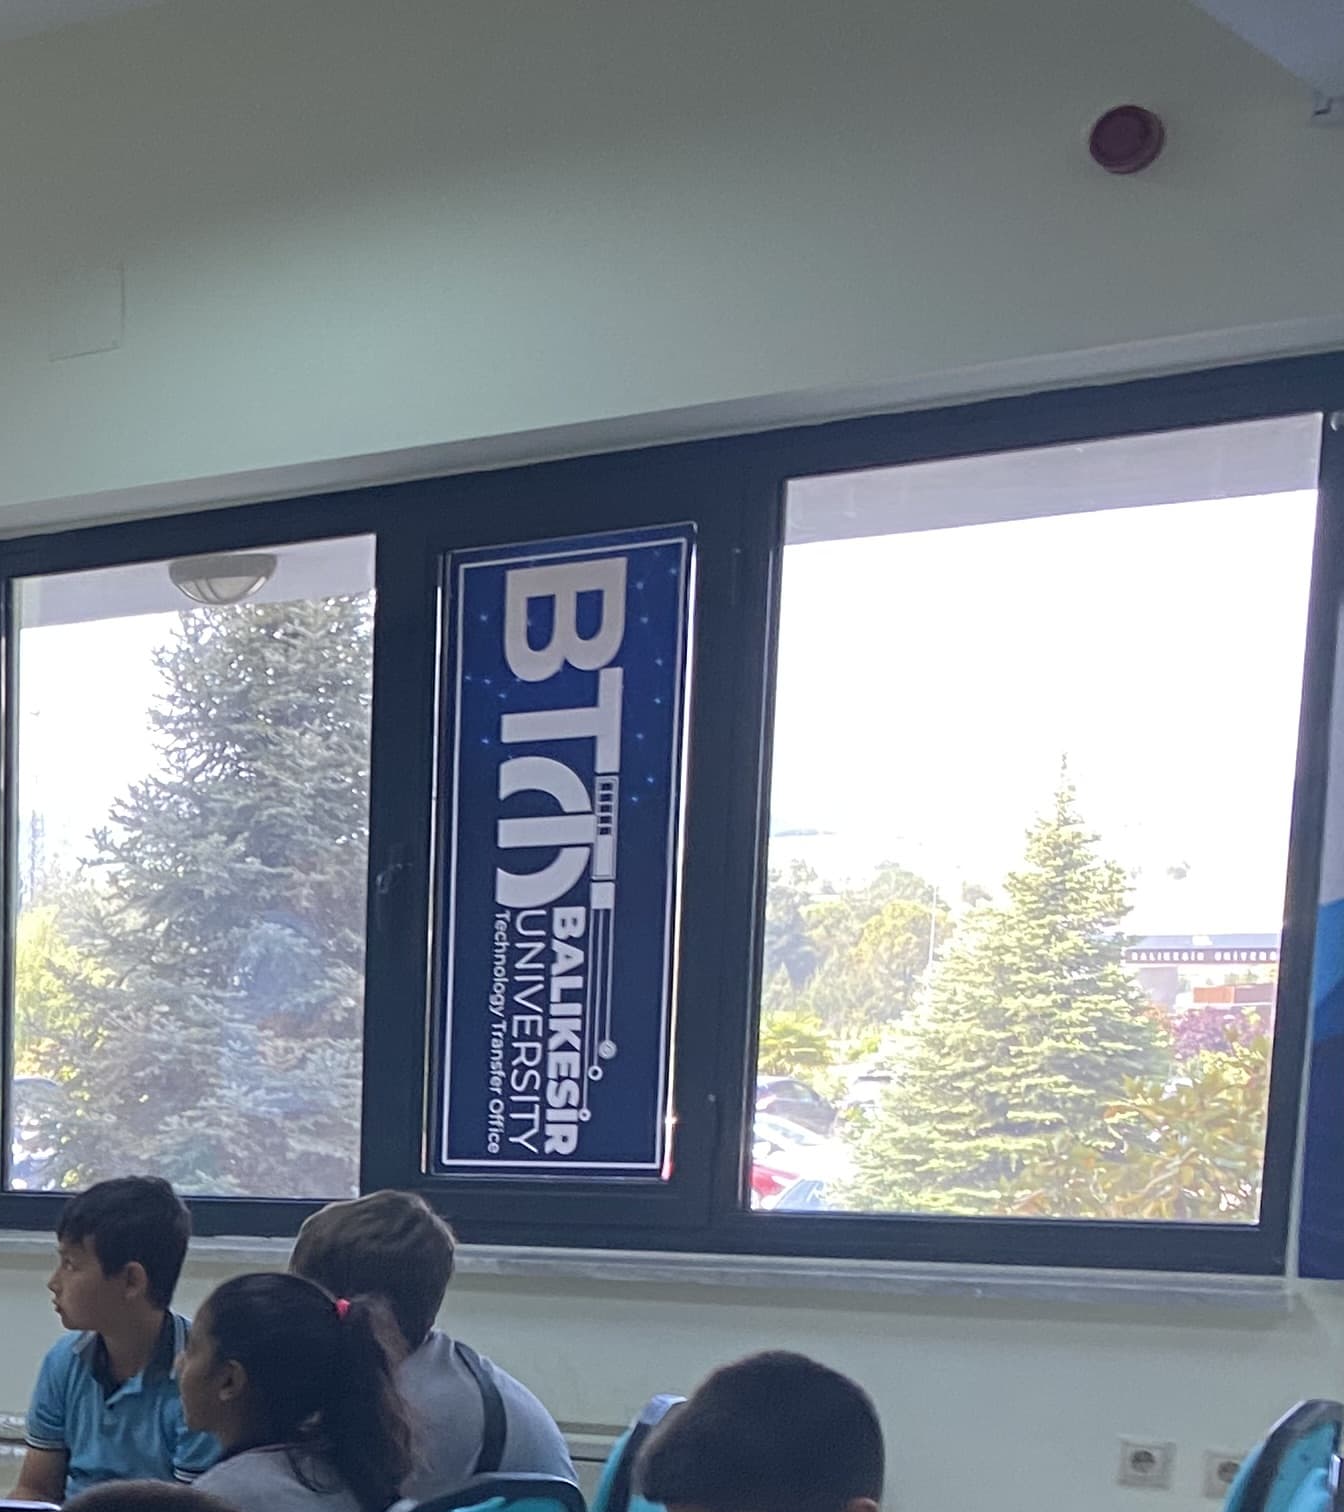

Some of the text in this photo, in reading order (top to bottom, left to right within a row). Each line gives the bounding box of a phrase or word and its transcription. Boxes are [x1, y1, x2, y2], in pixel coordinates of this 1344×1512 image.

[487, 910, 511, 1154] Technology Transfer Office
[509, 909, 547, 1154] UNIVERSITY
